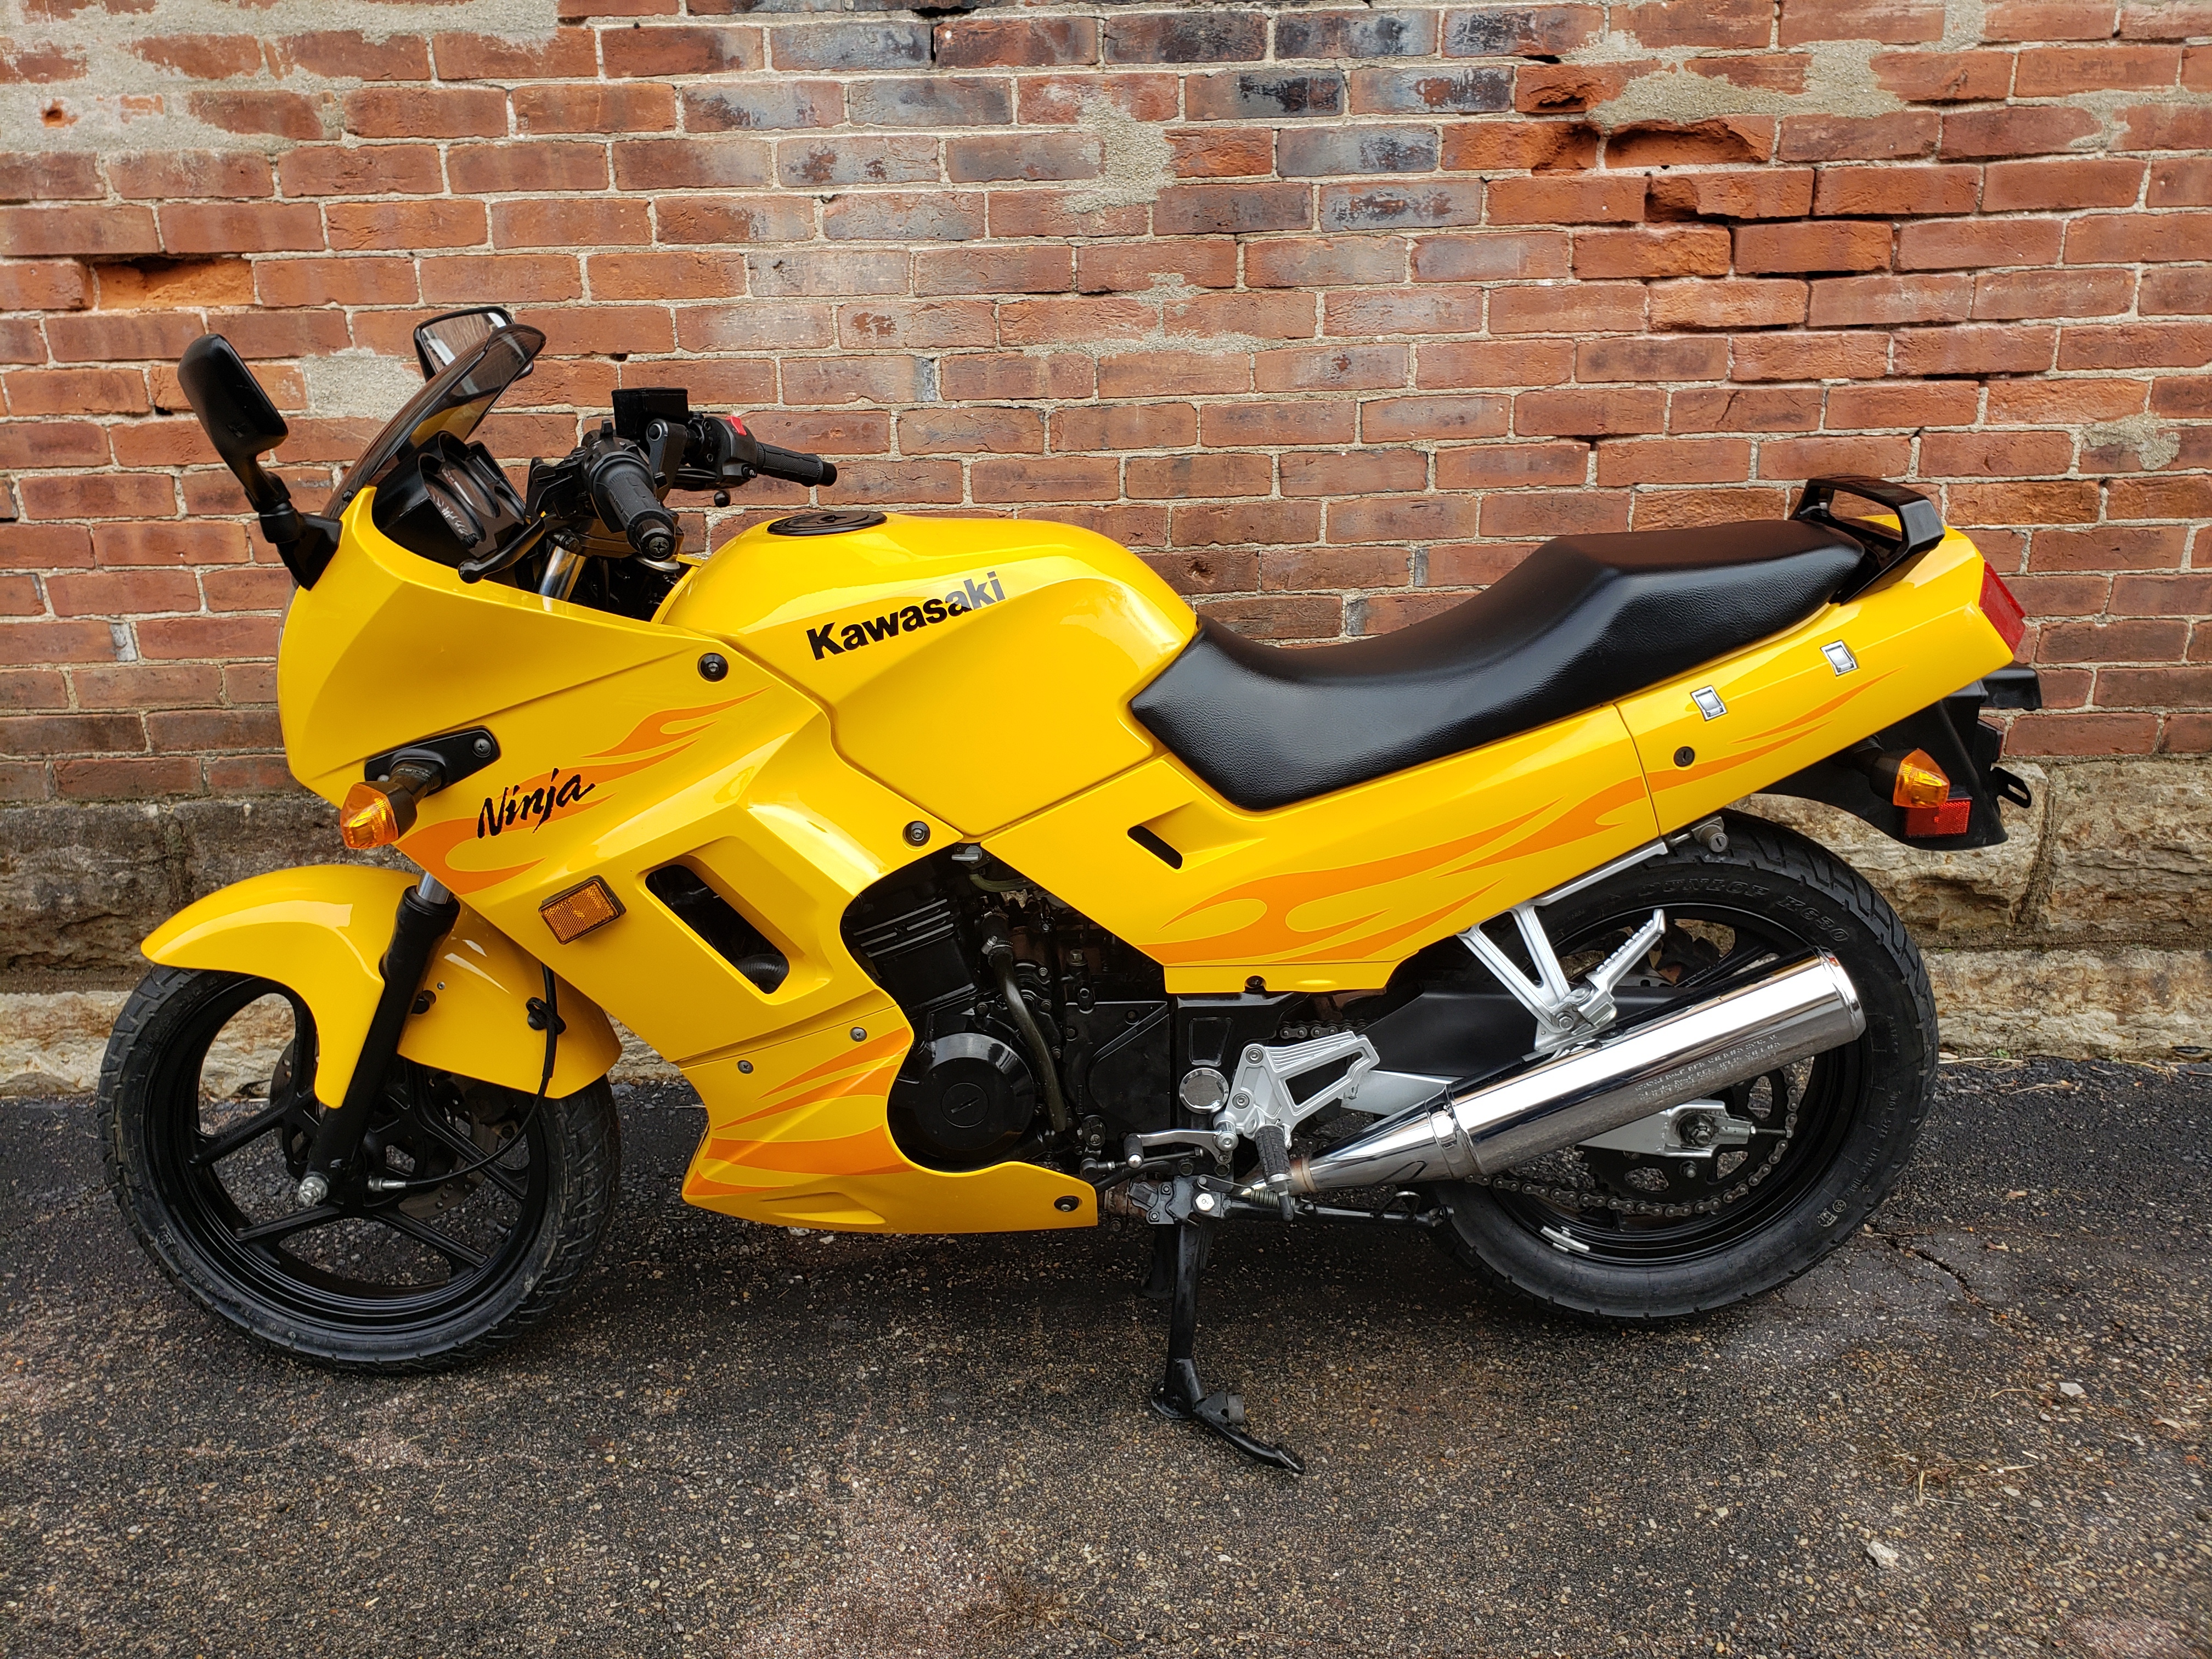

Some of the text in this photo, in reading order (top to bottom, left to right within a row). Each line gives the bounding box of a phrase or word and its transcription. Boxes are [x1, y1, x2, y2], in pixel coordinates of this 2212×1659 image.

[806, 571, 1006, 661] Kawasaki
[477, 768, 596, 839] Ninja
[1638, 878, 1850, 943] DUNLOP K630
